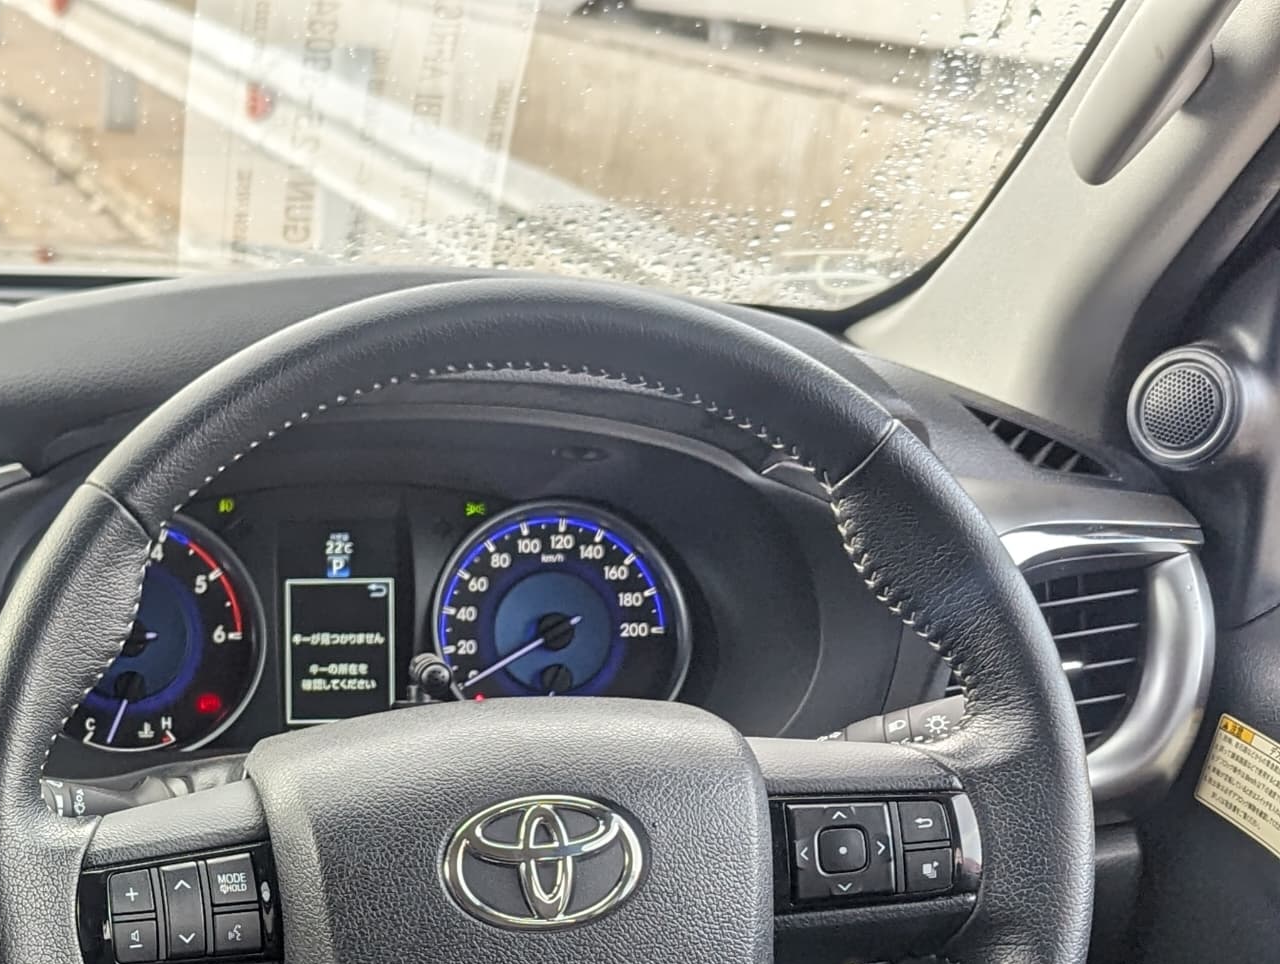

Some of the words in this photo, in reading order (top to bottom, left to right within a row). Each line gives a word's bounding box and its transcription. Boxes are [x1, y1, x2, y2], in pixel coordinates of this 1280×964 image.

[517, 538, 541, 554] 100
[550, 534, 574, 550] 120
[151, 543, 164, 561] 4
[541, 553, 564, 563] km/h
[580, 545, 604, 560] 140
[490, 552, 511, 568] 80
[604, 565, 629, 580] 160
[194, 575, 208, 594] 5
[468, 577, 488, 592] 60
[618, 592, 643, 607] 180
[456, 606, 477, 621] 40
[212, 625, 226, 643] 6
[620, 622, 648, 637] 200
[457, 640, 477, 655] 20
[85, 718, 95, 731] C
[161, 717, 171, 730] H
[217, 872, 248, 885] MODE
[227, 883, 248, 893] HOLD
